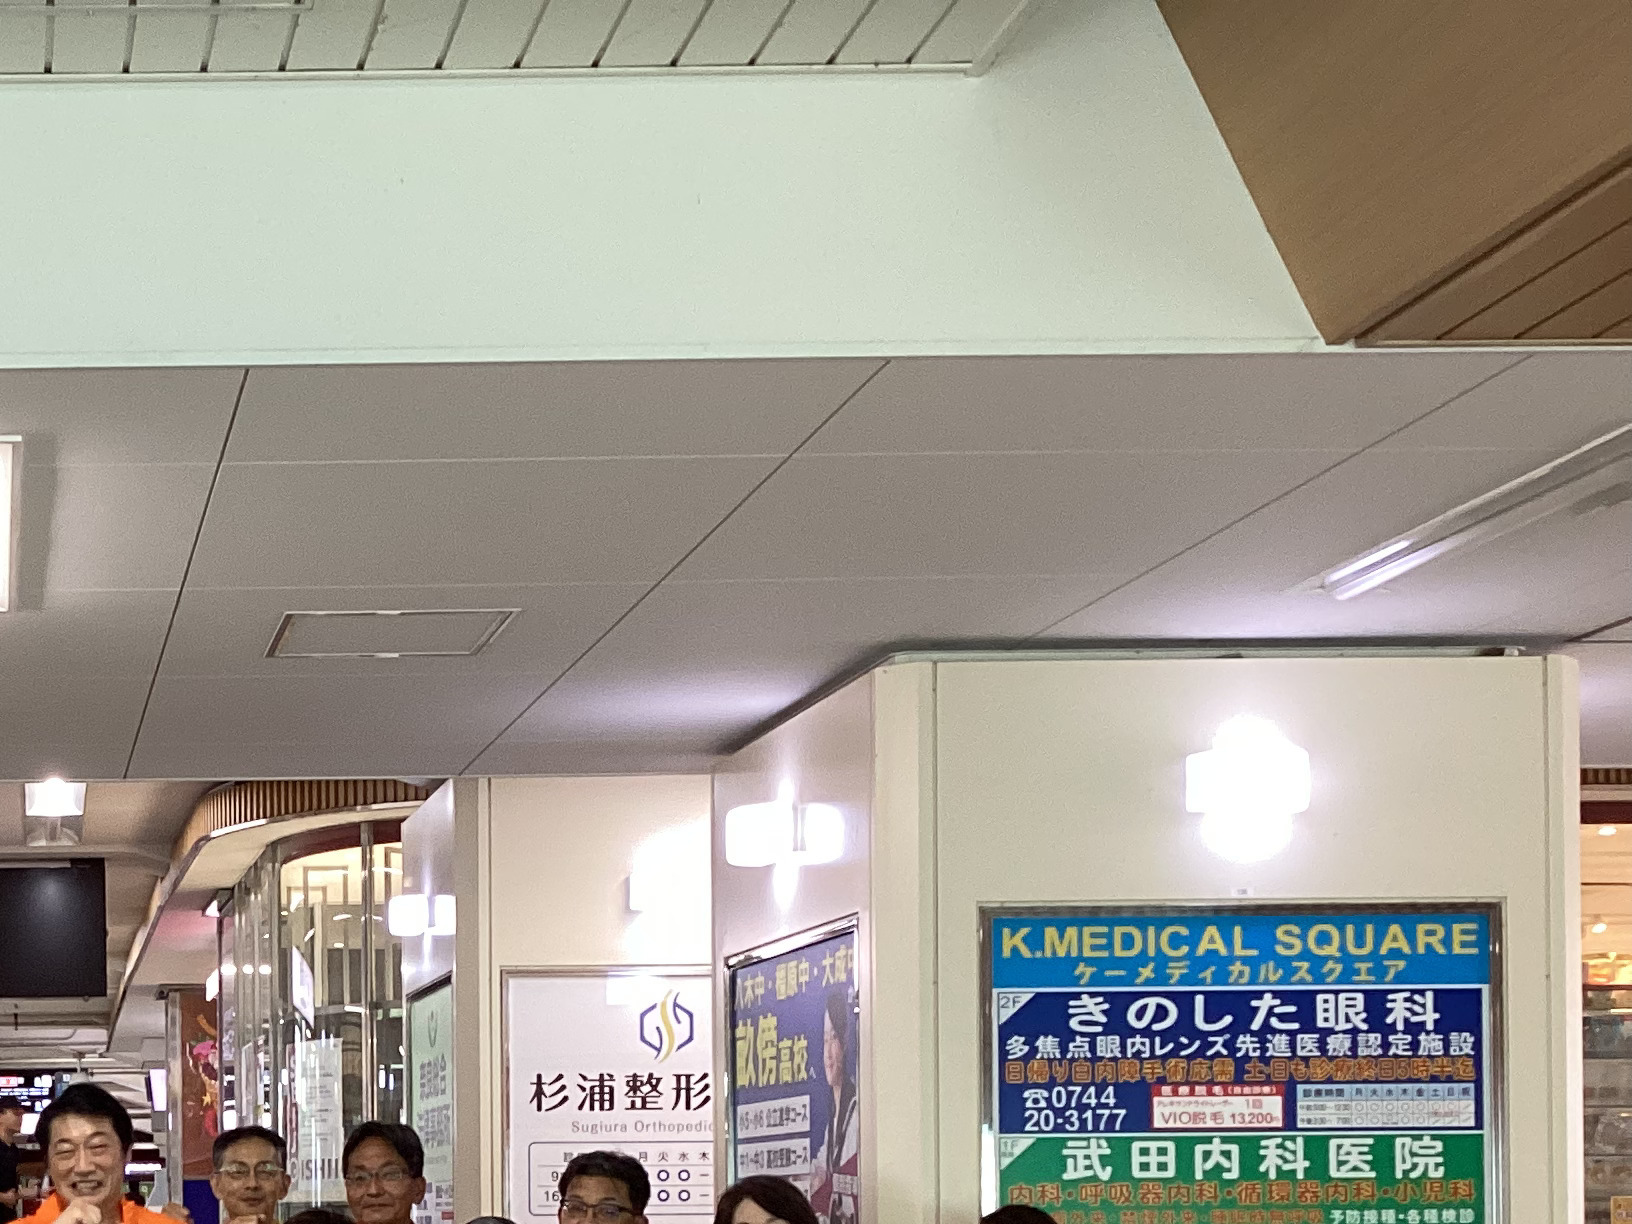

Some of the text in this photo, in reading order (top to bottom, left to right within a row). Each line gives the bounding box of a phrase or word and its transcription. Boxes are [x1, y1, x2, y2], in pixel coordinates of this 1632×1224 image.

[1001, 923, 1480, 958] K.MEDICAL SQUARE
[1073, 960, 1409, 985] ケーメディカルスクエア
[1000, 995, 1022, 1010] 2F
[1067, 991, 1441, 1033] きのした眼科
[1005, 1032, 1476, 1060] 多焦点眼内レンズ先進医療認定施設
[1005, 1058, 1235, 1084] 日帰り白内障手術応需
[529, 1072, 712, 1112] 杉浦整形
[1051, 1085, 1117, 1107] 0744
[571, 1120, 627, 1134] Sugiura
[1024, 1109, 1127, 1132] 20-3177
[1161, 1111, 1225, 1125] VIO脱毛
[658, 1152, 669, 1162] 火
[678, 1152, 689, 1162] 水
[699, 1152, 710, 1161] 木
[1061, 1136, 1445, 1181] 武田内科医院
[1009, 1179, 1476, 1206] 内科・呼吸器内科・循環器内科・小児科
